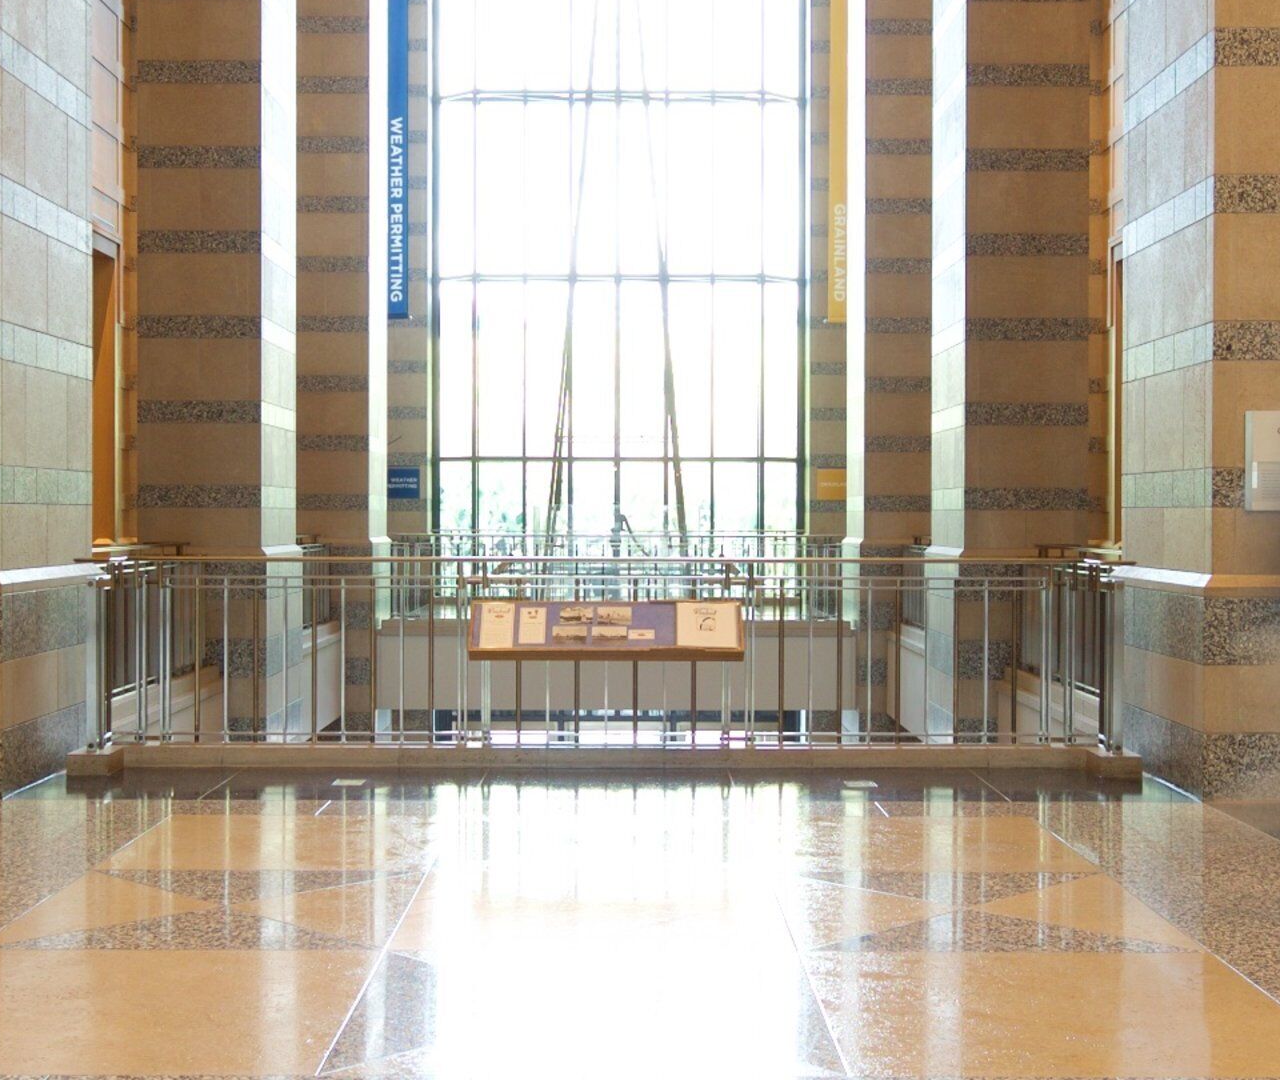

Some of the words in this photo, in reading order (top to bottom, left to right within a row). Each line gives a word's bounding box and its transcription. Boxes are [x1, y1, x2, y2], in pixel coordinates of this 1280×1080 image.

[389, 116, 404, 199] WEATHER
[389, 202, 404, 303] PERMITTING
[833, 203, 846, 302] GRAINLAND
